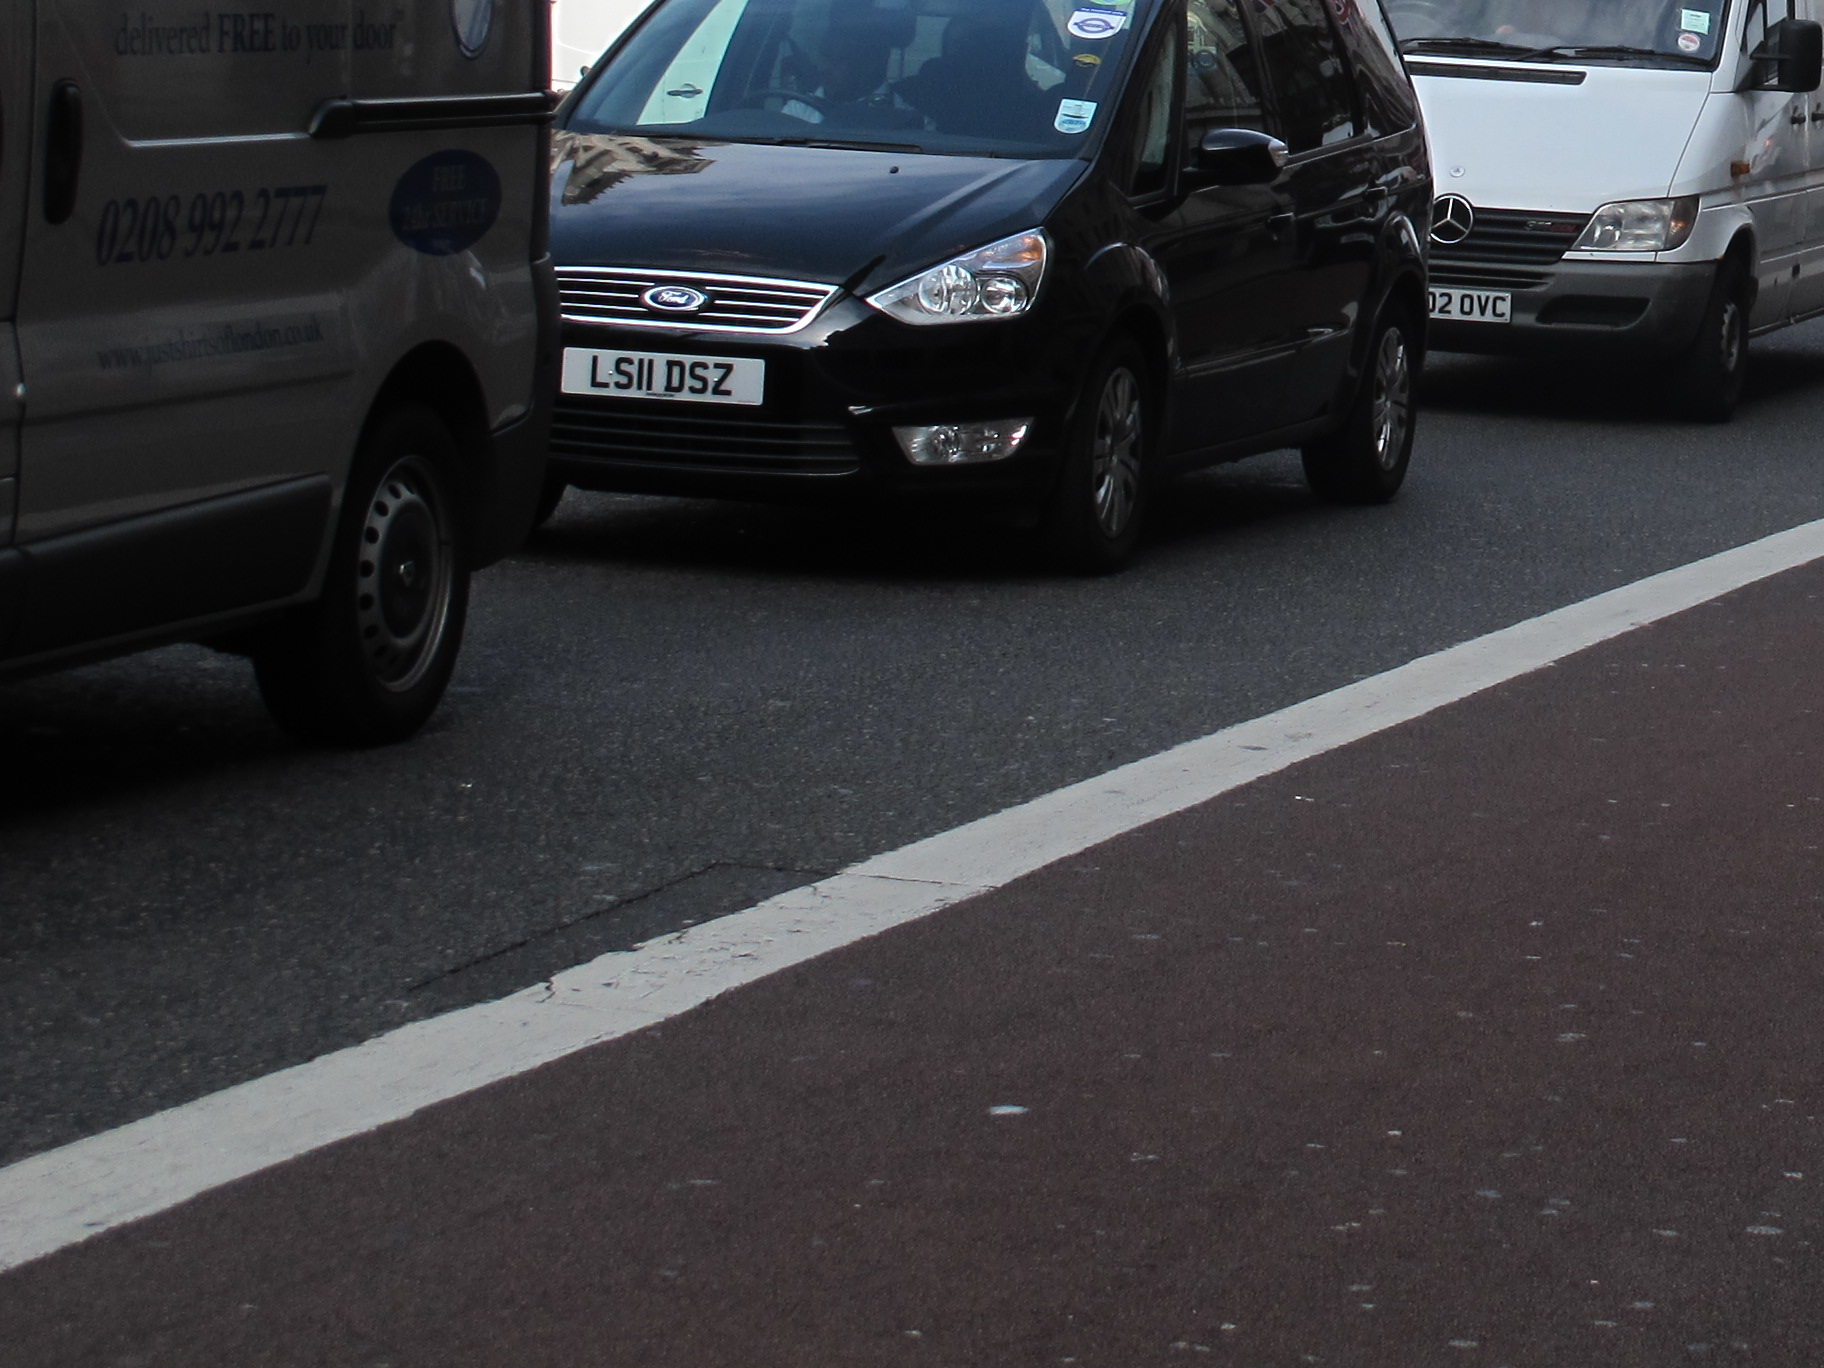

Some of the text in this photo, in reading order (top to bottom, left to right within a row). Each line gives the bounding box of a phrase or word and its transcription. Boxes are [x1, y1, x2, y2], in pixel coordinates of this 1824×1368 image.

[115, 11, 211, 56] delivered
[217, 12, 276, 53] FREE
[281, 19, 300, 52] to
[306, 23, 348, 65] your
[432, 164, 466, 192] FREE
[96, 184, 328, 266] 0208 992 2777
[432, 198, 489, 229] SERVICE
[658, 289, 690, 305] Ford
[1429, 291, 1507, 318] 02 OVC
[590, 355, 735, 397] LS11 DSZ
